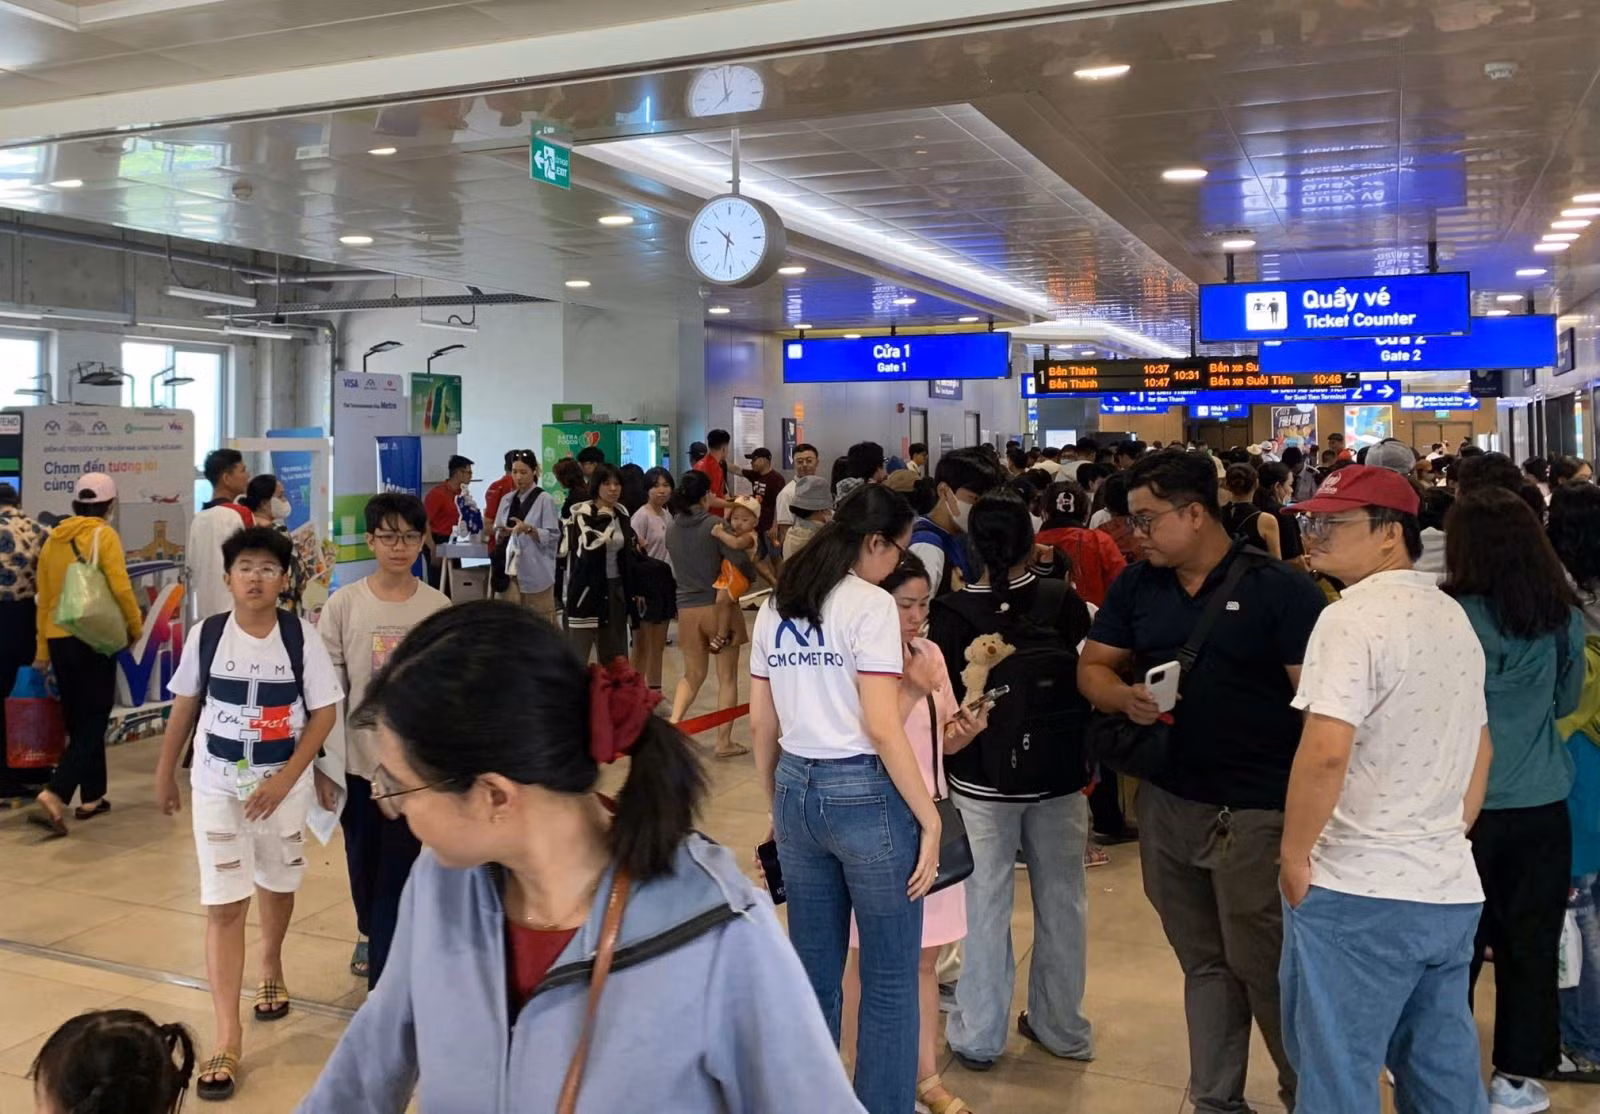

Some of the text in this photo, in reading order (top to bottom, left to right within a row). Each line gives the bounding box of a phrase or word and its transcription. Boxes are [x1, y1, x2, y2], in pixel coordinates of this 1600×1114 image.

[1302, 286, 1391, 312] Quầy vé
[1303, 312, 1417, 328] Ticket Counter
[873, 344, 910, 359] Cửa 1
[1380, 349, 1422, 362] Gate 2
[877, 361, 907, 373] Gate 1
[1049, 364, 1170, 376] Bến Thành 10:37
[1209, 361, 1230, 373] Bến
[1232, 364, 1244, 372] xe
[1038, 370, 1045, 385] 1
[1173, 370, 1200, 380] 10:31
[1210, 374, 1230, 386] Bến
[1232, 377, 1244, 385] xe
[1271, 375, 1294, 385] Tiên
[1312, 374, 1342, 385] 10:46
[343, 379, 359, 388] VISA
[1049, 377, 1170, 389] Bến Thành 10:47
[44, 461, 80, 479] Chạm
[83, 458, 105, 474] đến
[44, 476, 74, 493] cùng
